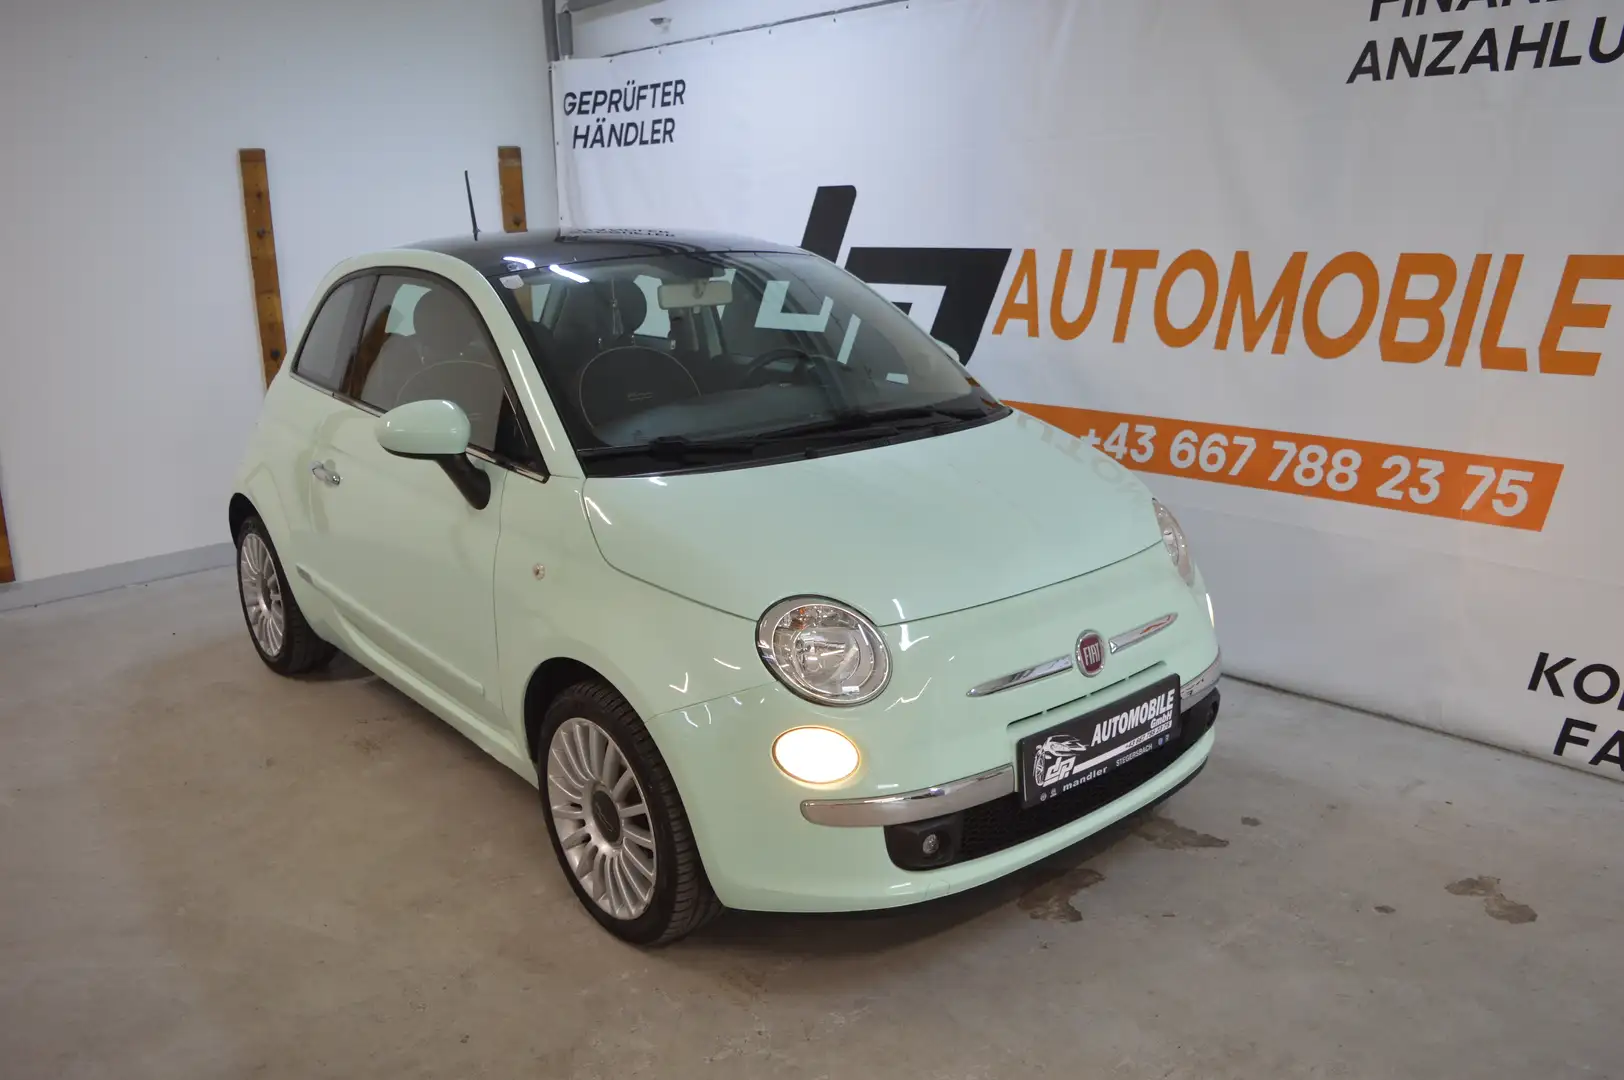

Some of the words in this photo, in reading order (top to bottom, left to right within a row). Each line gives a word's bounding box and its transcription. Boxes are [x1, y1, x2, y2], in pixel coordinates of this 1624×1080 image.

[1345, 16, 1624, 84] ANZAHLU
[563, 79, 686, 116] GEPRÜFTER
[572, 117, 676, 149] HÄNDLER
[992, 248, 1624, 376] AUTOMOBILE
[1080, 422, 1157, 463] +43
[1169, 429, 1257, 476] 667
[1267, 440, 1362, 492] 788
[1375, 455, 1445, 504] 23
[1460, 464, 1535, 517] 75
[1082, 642, 1101, 666] FIAT
[1527, 652, 1624, 711] KO
[1090, 688, 1176, 747] AUTOMOBILE
[1150, 709, 1173, 729] GmbH
[1115, 743, 1153, 768] STEGERSBACH
[1063, 766, 1108, 792] mandler
